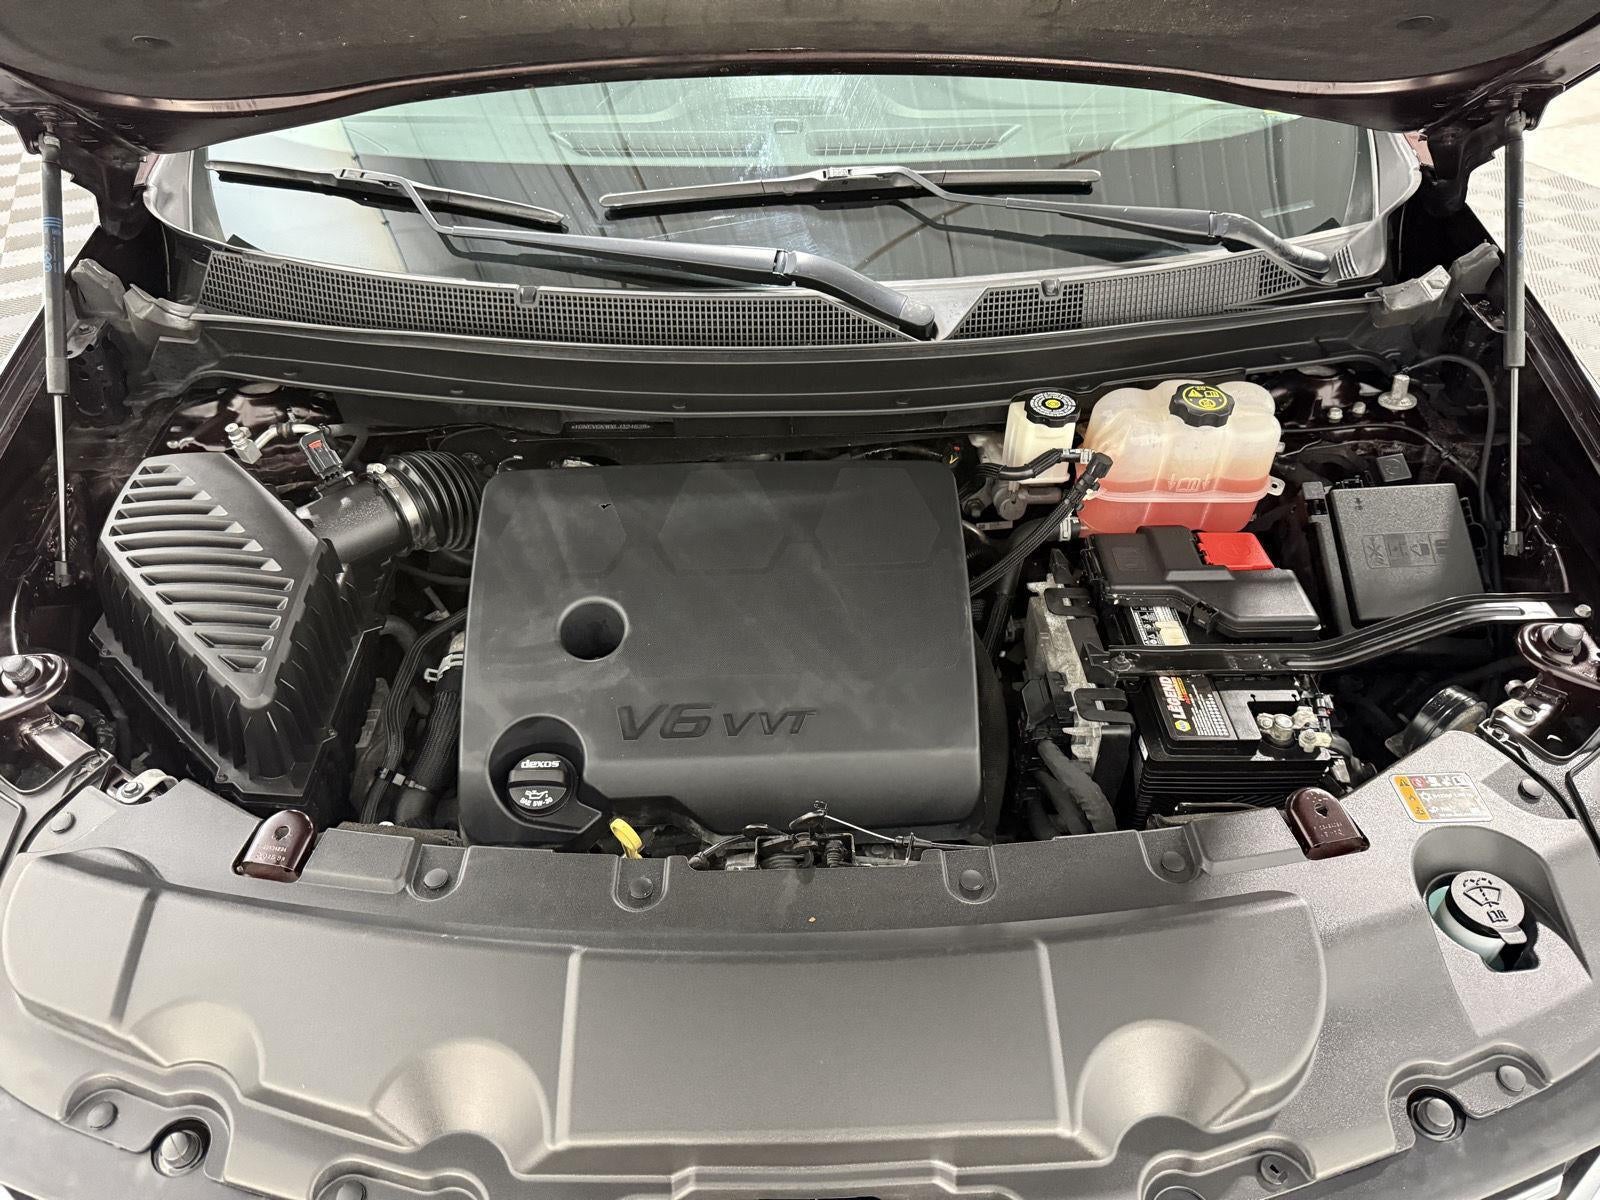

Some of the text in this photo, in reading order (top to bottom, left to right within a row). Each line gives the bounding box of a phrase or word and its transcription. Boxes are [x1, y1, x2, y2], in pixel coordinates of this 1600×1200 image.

[1158, 676, 1187, 720] LEGEND
[616, 703, 817, 741] V6 VVT
[520, 759, 561, 769] dexos
